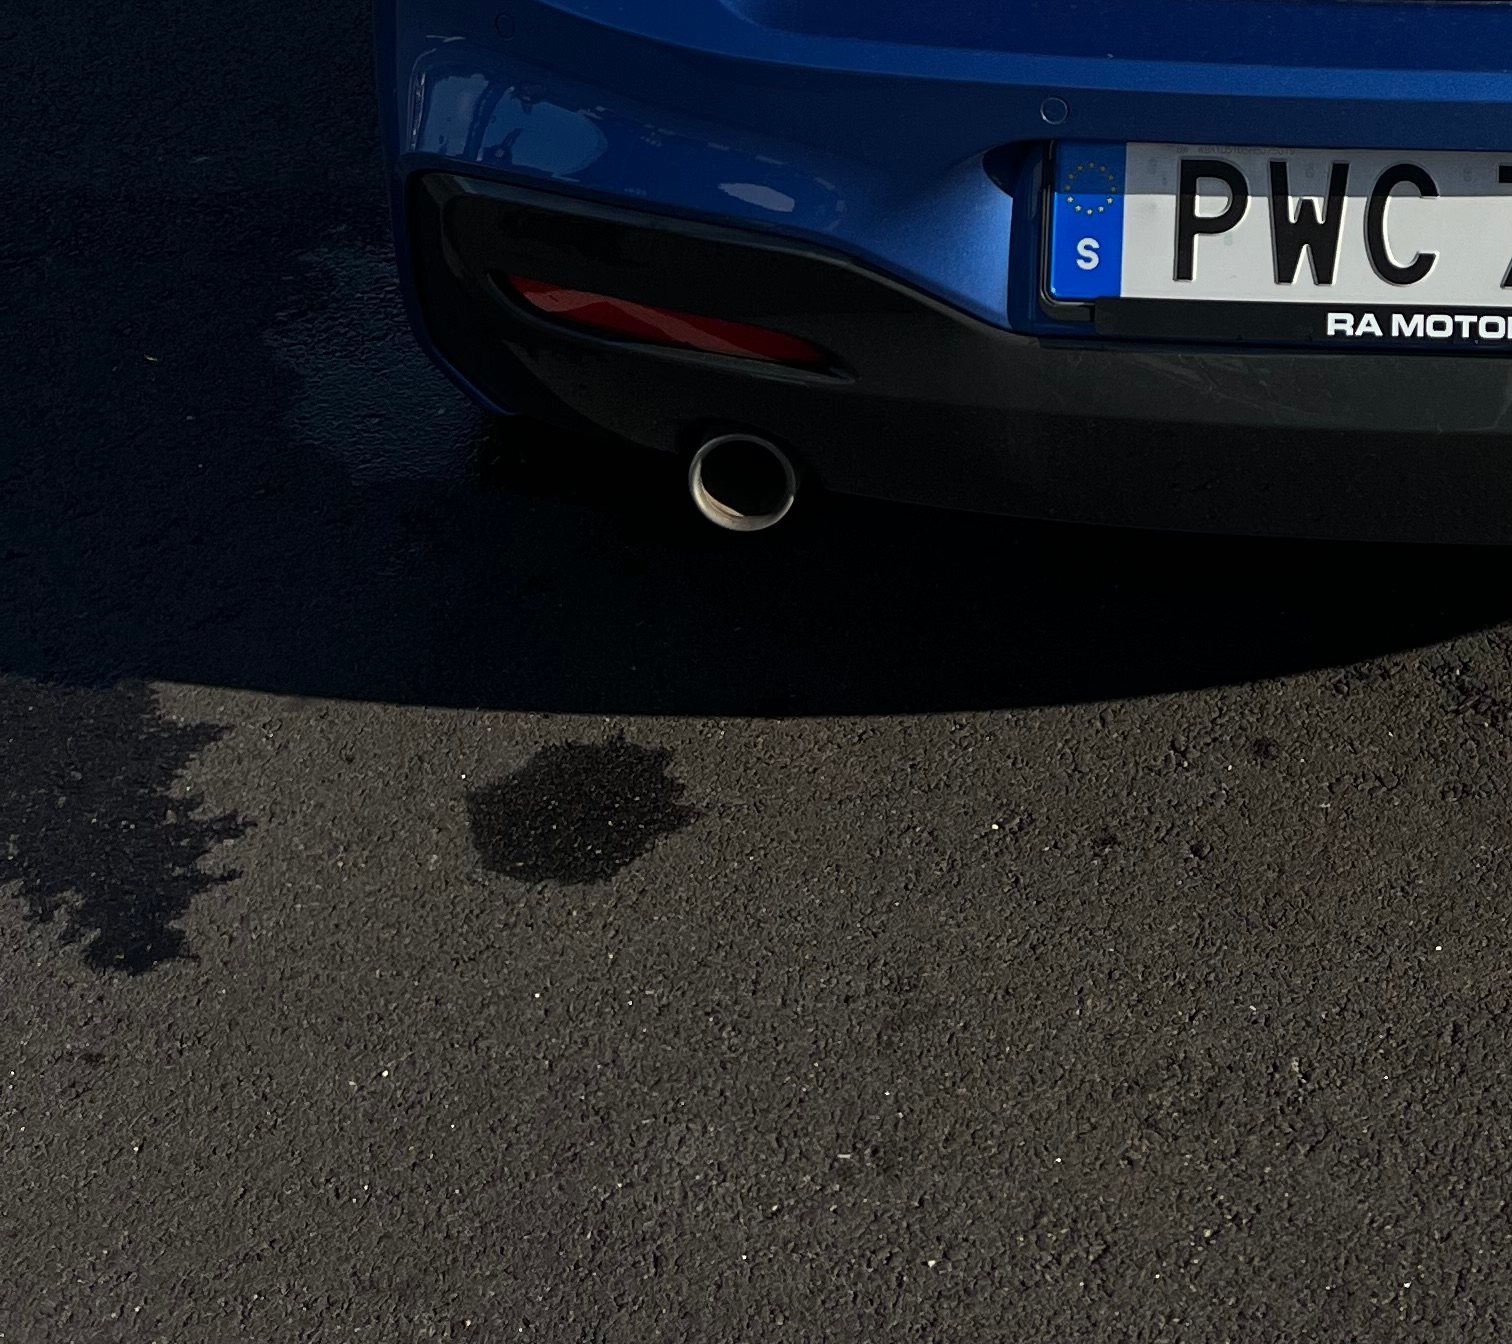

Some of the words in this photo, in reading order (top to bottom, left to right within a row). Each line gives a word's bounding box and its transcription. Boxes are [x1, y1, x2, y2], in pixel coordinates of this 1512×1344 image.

[1173, 157, 1441, 286] PWC
[1075, 237, 1100, 271] S
[1327, 312, 1383, 339] RA
